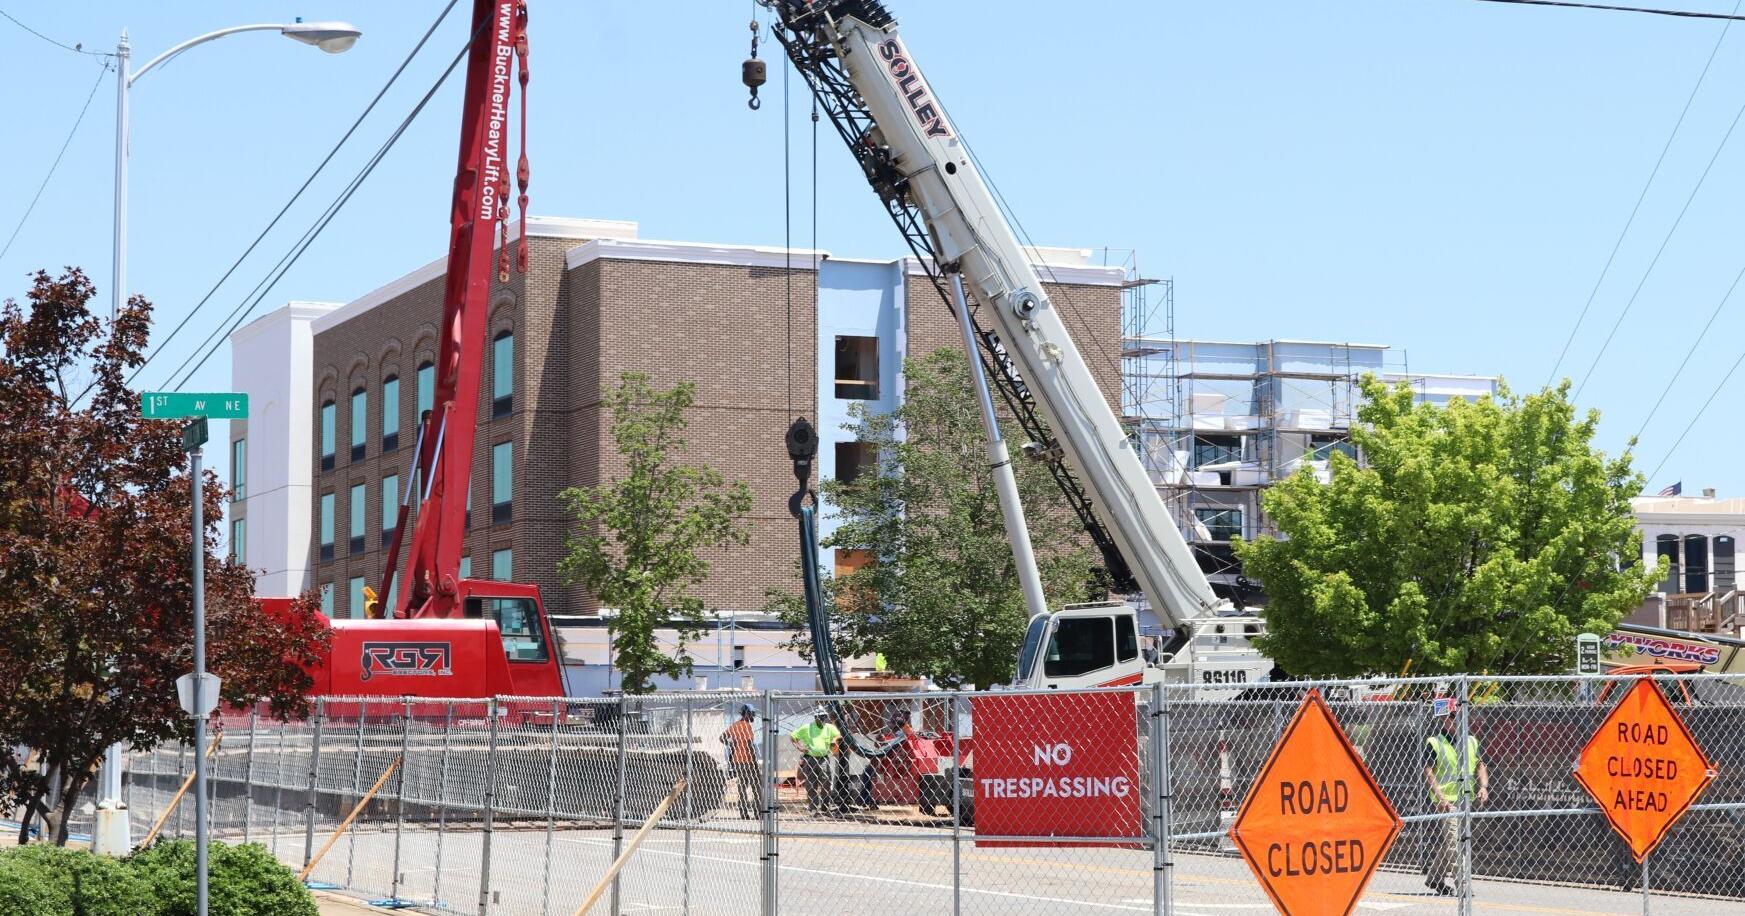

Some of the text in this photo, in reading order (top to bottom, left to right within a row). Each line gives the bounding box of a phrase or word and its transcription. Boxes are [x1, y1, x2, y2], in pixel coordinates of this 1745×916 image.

[878, 39, 950, 138] SOLLEY
[480, 3, 512, 220] www.BucknerHeavyLift.com
[150, 396, 241, 415] 1ST AV NE
[1609, 633, 1720, 664] YWORKS
[1618, 722, 1668, 746] ROAD
[1034, 743, 1073, 767] NO
[1607, 756, 1678, 781] CLOSED
[981, 776, 1130, 799] TRESPASSING
[1280, 780, 1349, 815] ROAD
[1614, 790, 1668, 813] AHEAD
[1267, 839, 1365, 878] CLOSED
